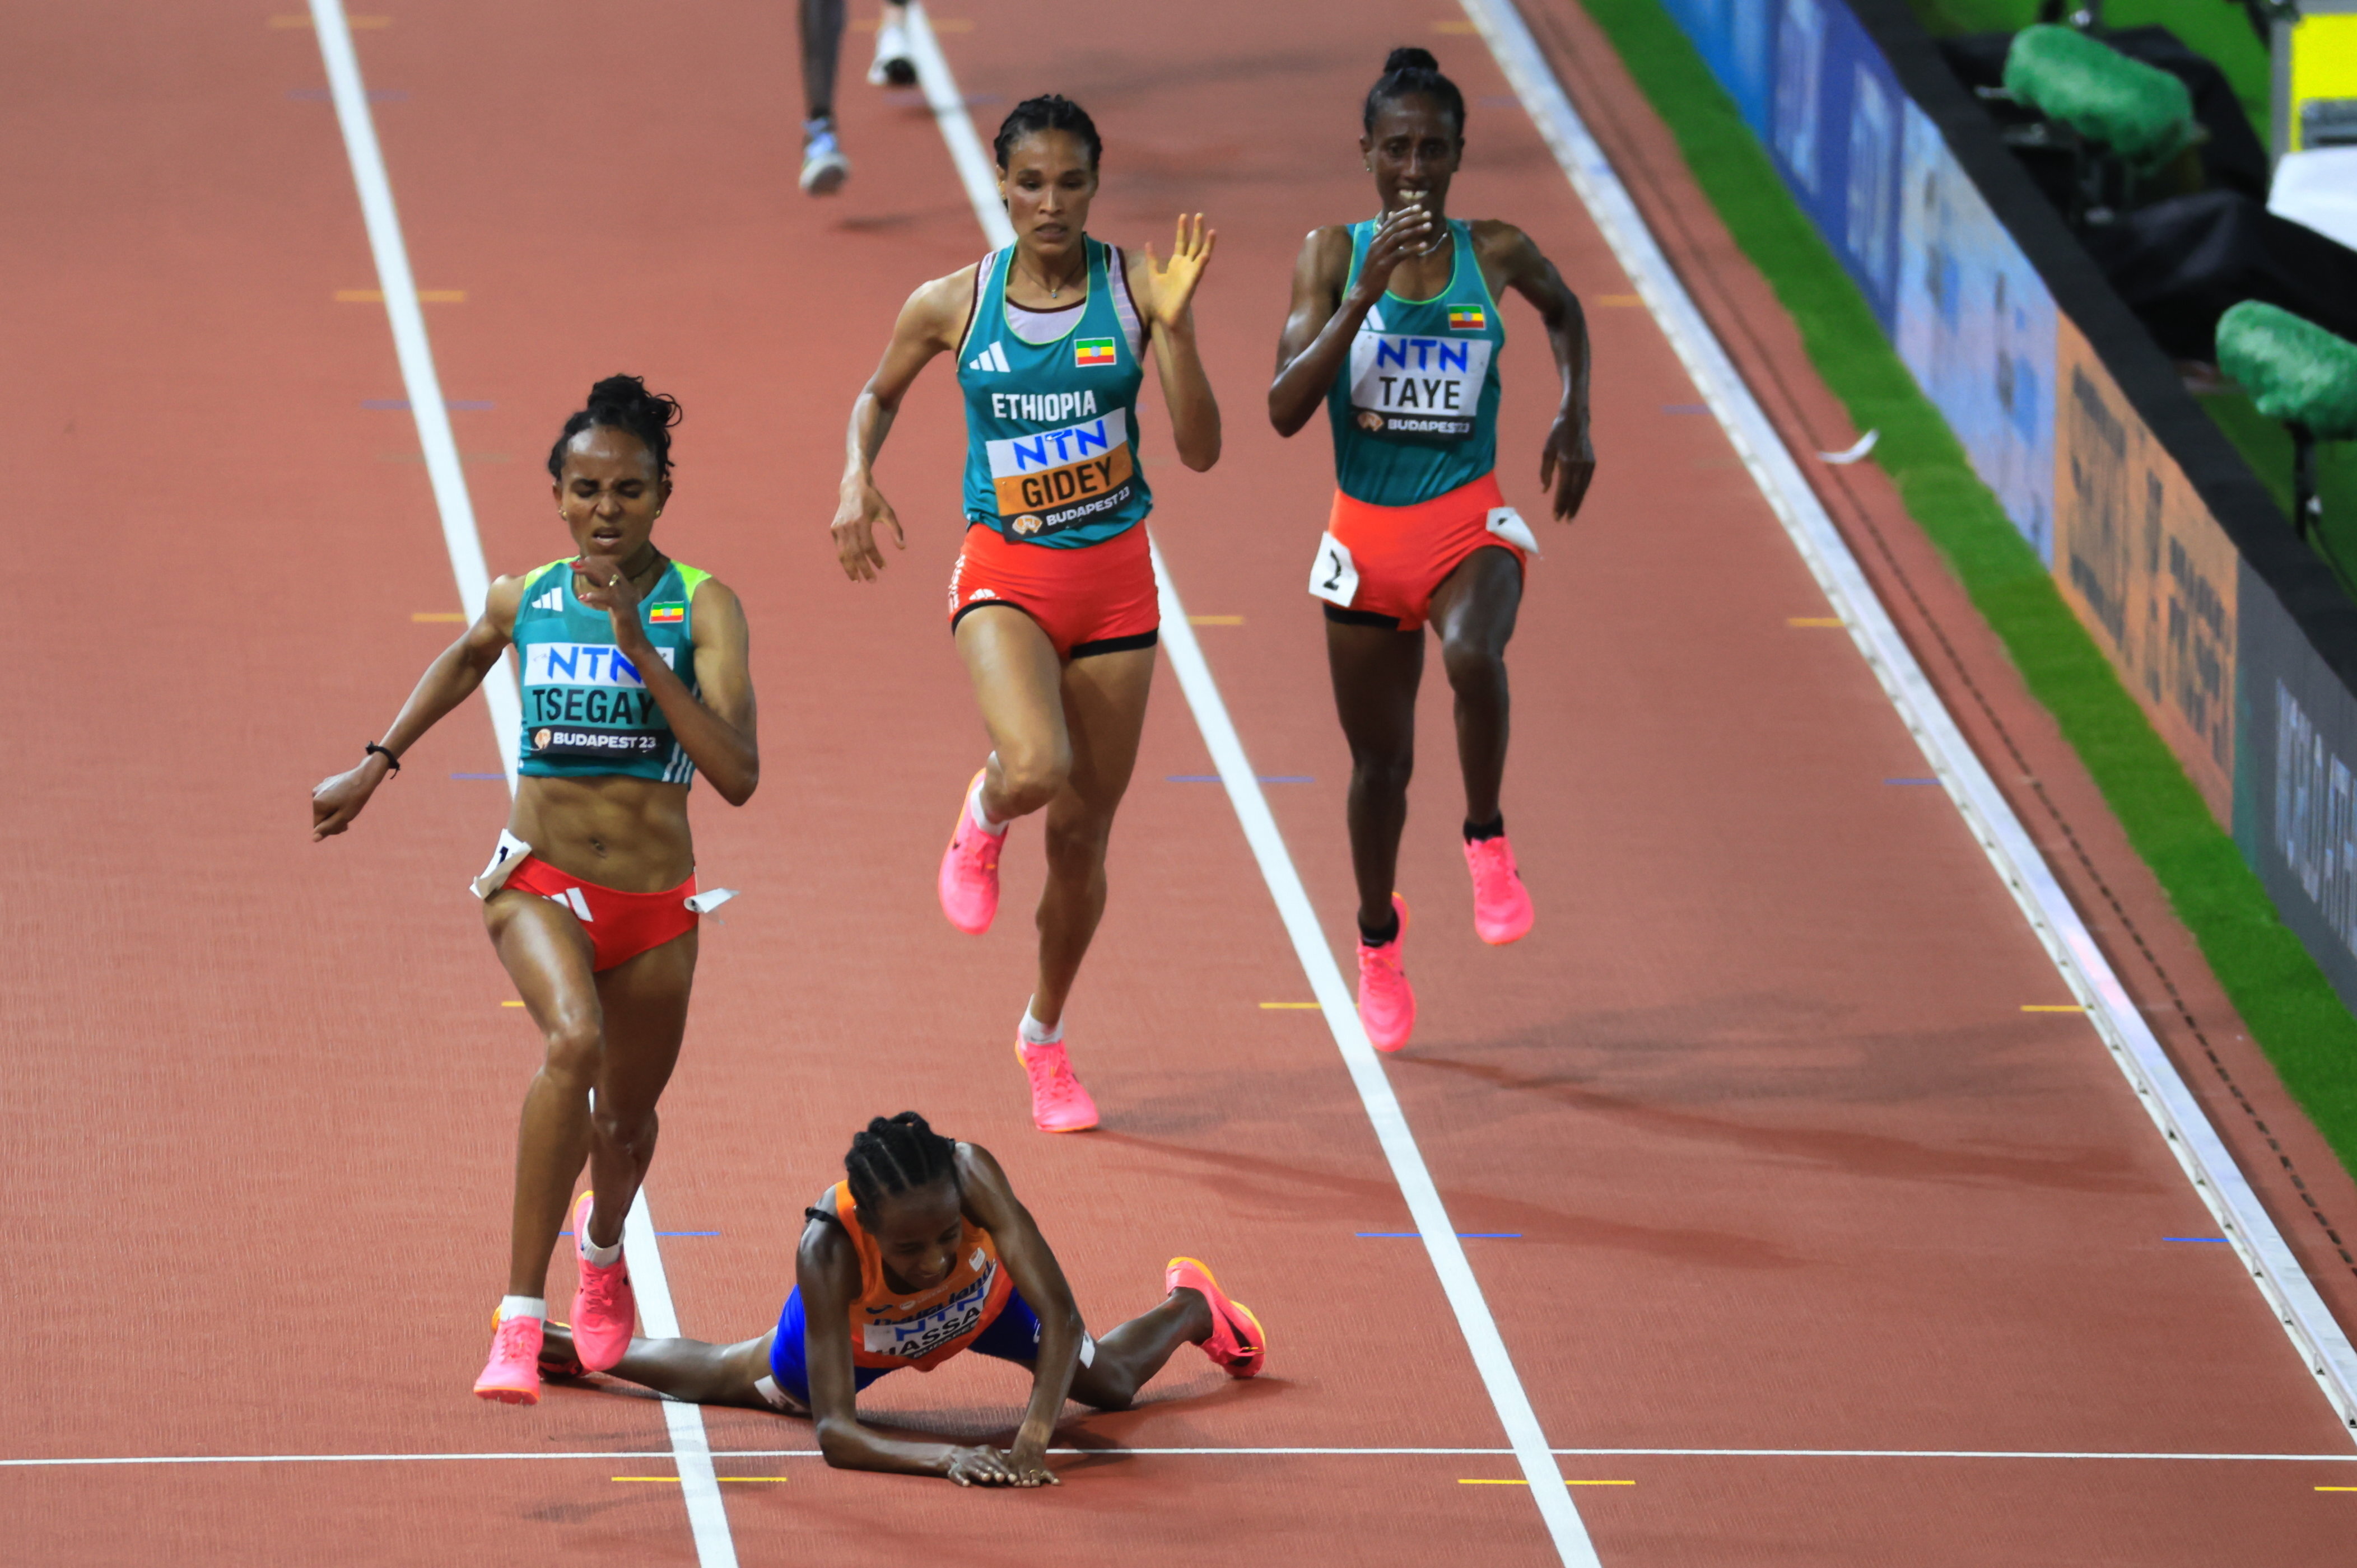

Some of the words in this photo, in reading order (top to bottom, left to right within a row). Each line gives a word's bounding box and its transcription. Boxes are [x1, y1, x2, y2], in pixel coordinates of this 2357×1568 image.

[1377, 338, 1468, 374] NTN
[991, 390, 1097, 421] ETHIOPIA
[1379, 376, 1461, 410] TAYE
[1387, 418, 1455, 433] BUDAPES
[1013, 419, 1108, 471] NTN
[1021, 456, 1112, 508] GIDEY
[1046, 493, 1119, 526] BUDAPEST
[547, 646, 642, 684] NTN
[533, 688, 655, 725] TSEGAY
[553, 732, 638, 749] BUDAPEST
[639, 736, 656, 749] 23
